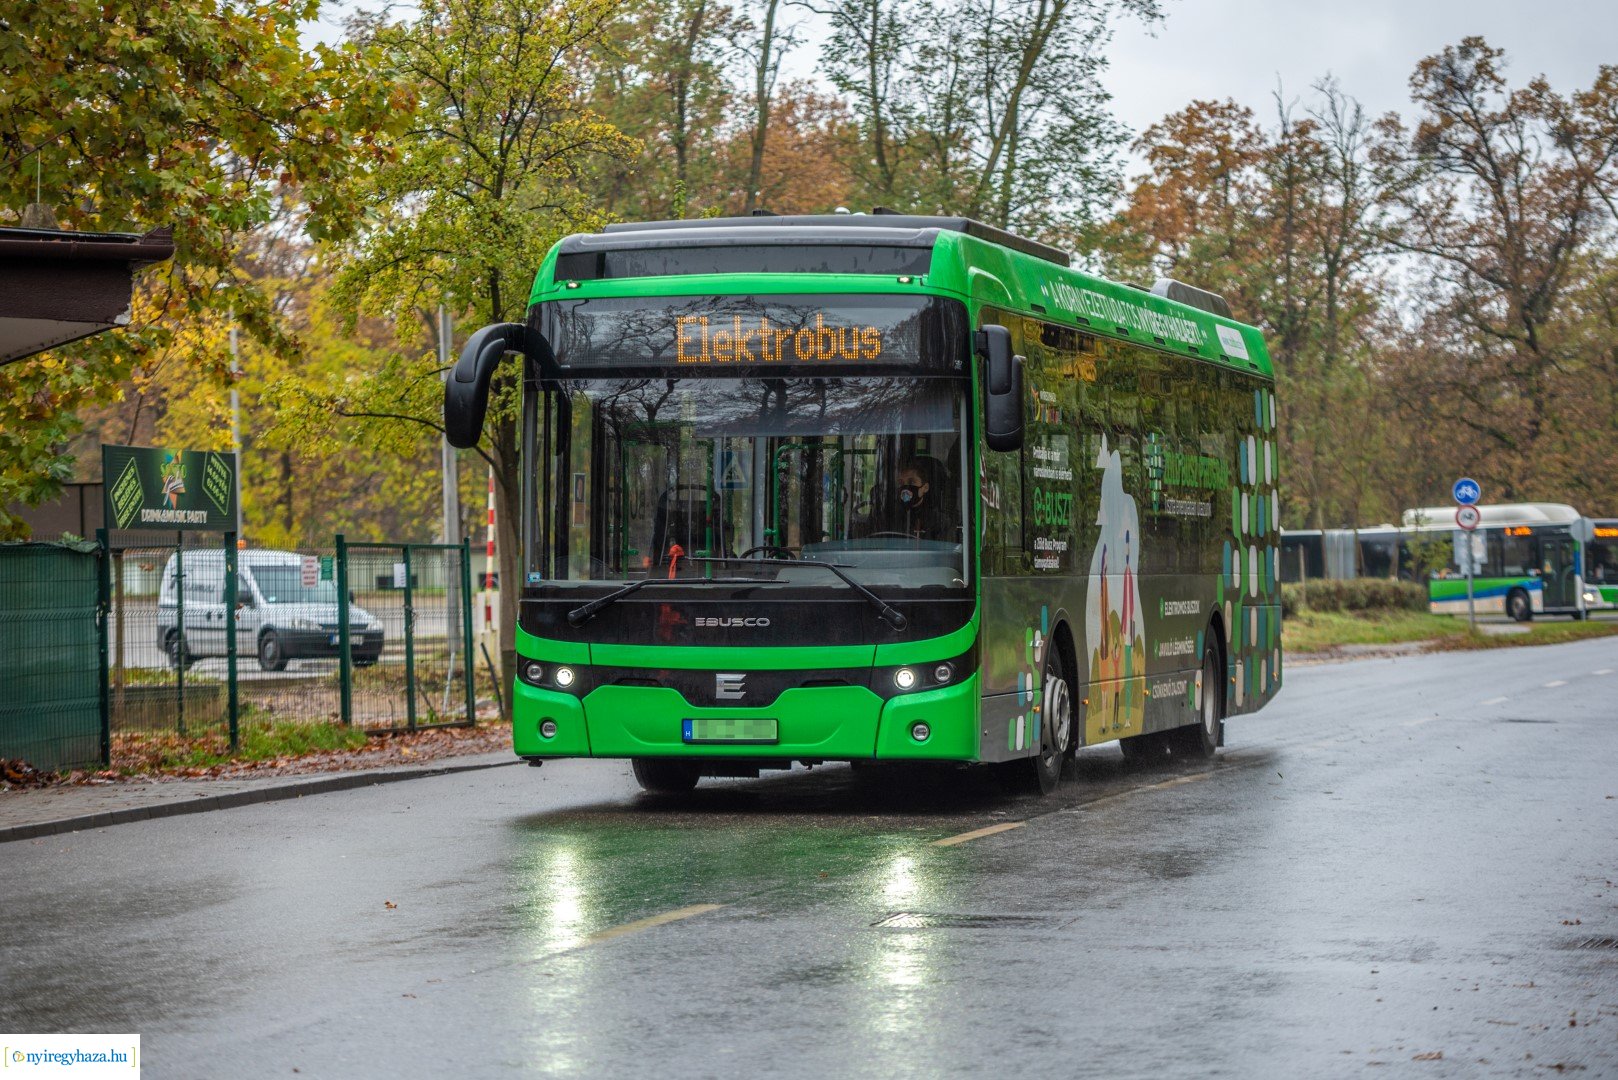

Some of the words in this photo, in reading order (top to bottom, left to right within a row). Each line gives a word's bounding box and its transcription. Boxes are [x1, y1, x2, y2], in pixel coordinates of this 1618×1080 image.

[677, 313, 881, 363] Elektrobus
[187, 509, 208, 524] PARTY
[695, 617, 771, 627] EBUSCO
[685, 729, 692, 738] H
